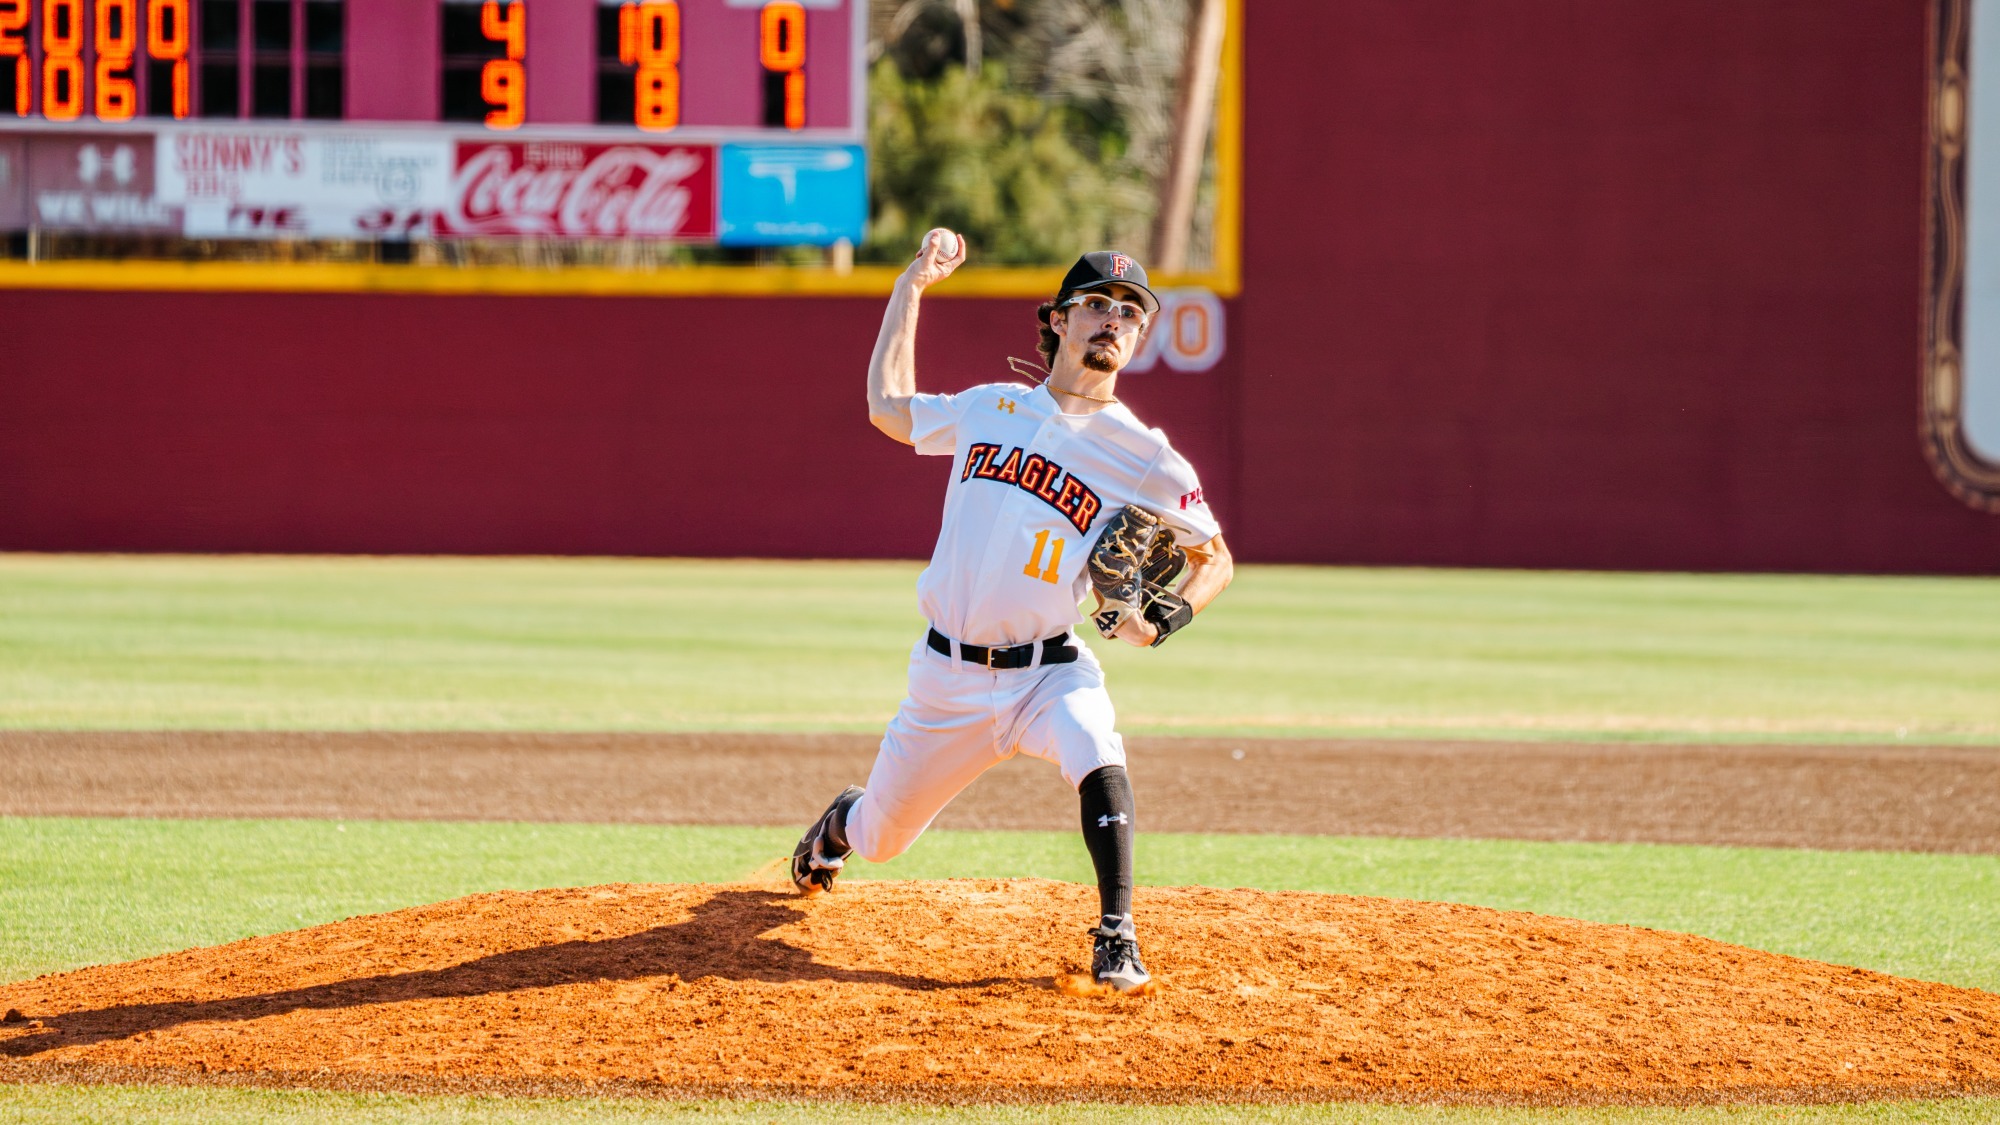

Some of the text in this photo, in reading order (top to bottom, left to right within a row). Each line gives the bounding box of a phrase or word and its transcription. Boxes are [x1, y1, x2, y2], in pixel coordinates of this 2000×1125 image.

[43, 0, 83, 55] 0
[95, 0, 136, 58] 0
[148, 0, 189, 60] 0
[481, 0, 526, 60] 4
[619, 1, 680, 66] 10
[760, 2, 806, 70] 0
[16, 54, 806, 132] 1 0 6 1 9 8 1
[176, 133, 304, 175] SONNY'S
[1110, 254, 1132, 278] F
[961, 443, 1103, 537] FLAGLER
[1023, 529, 1065, 585] 11
